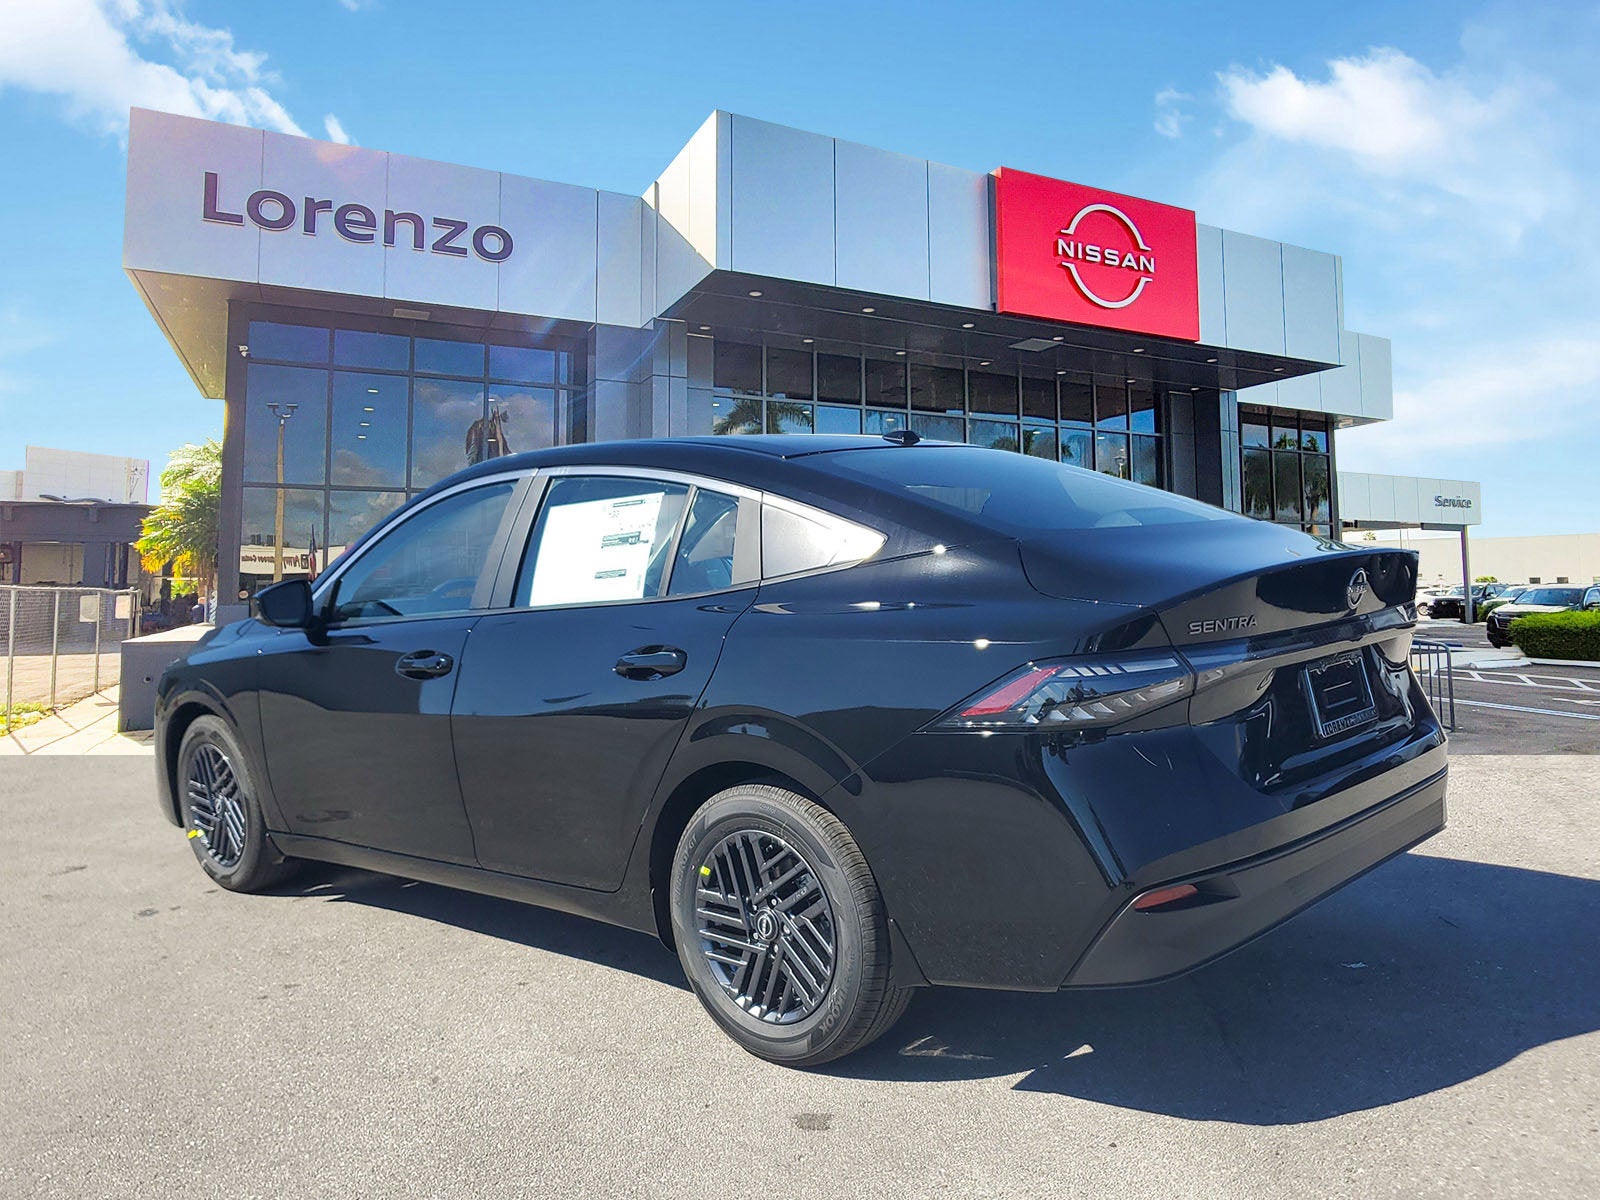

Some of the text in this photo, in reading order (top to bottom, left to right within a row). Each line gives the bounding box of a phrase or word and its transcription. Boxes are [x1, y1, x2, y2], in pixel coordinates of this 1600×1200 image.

[203, 171, 514, 262] Lorenzo
[1057, 238, 1155, 273] NISSAN
[1434, 495, 1472, 509] Service
[1188, 615, 1258, 635] SENTRA
